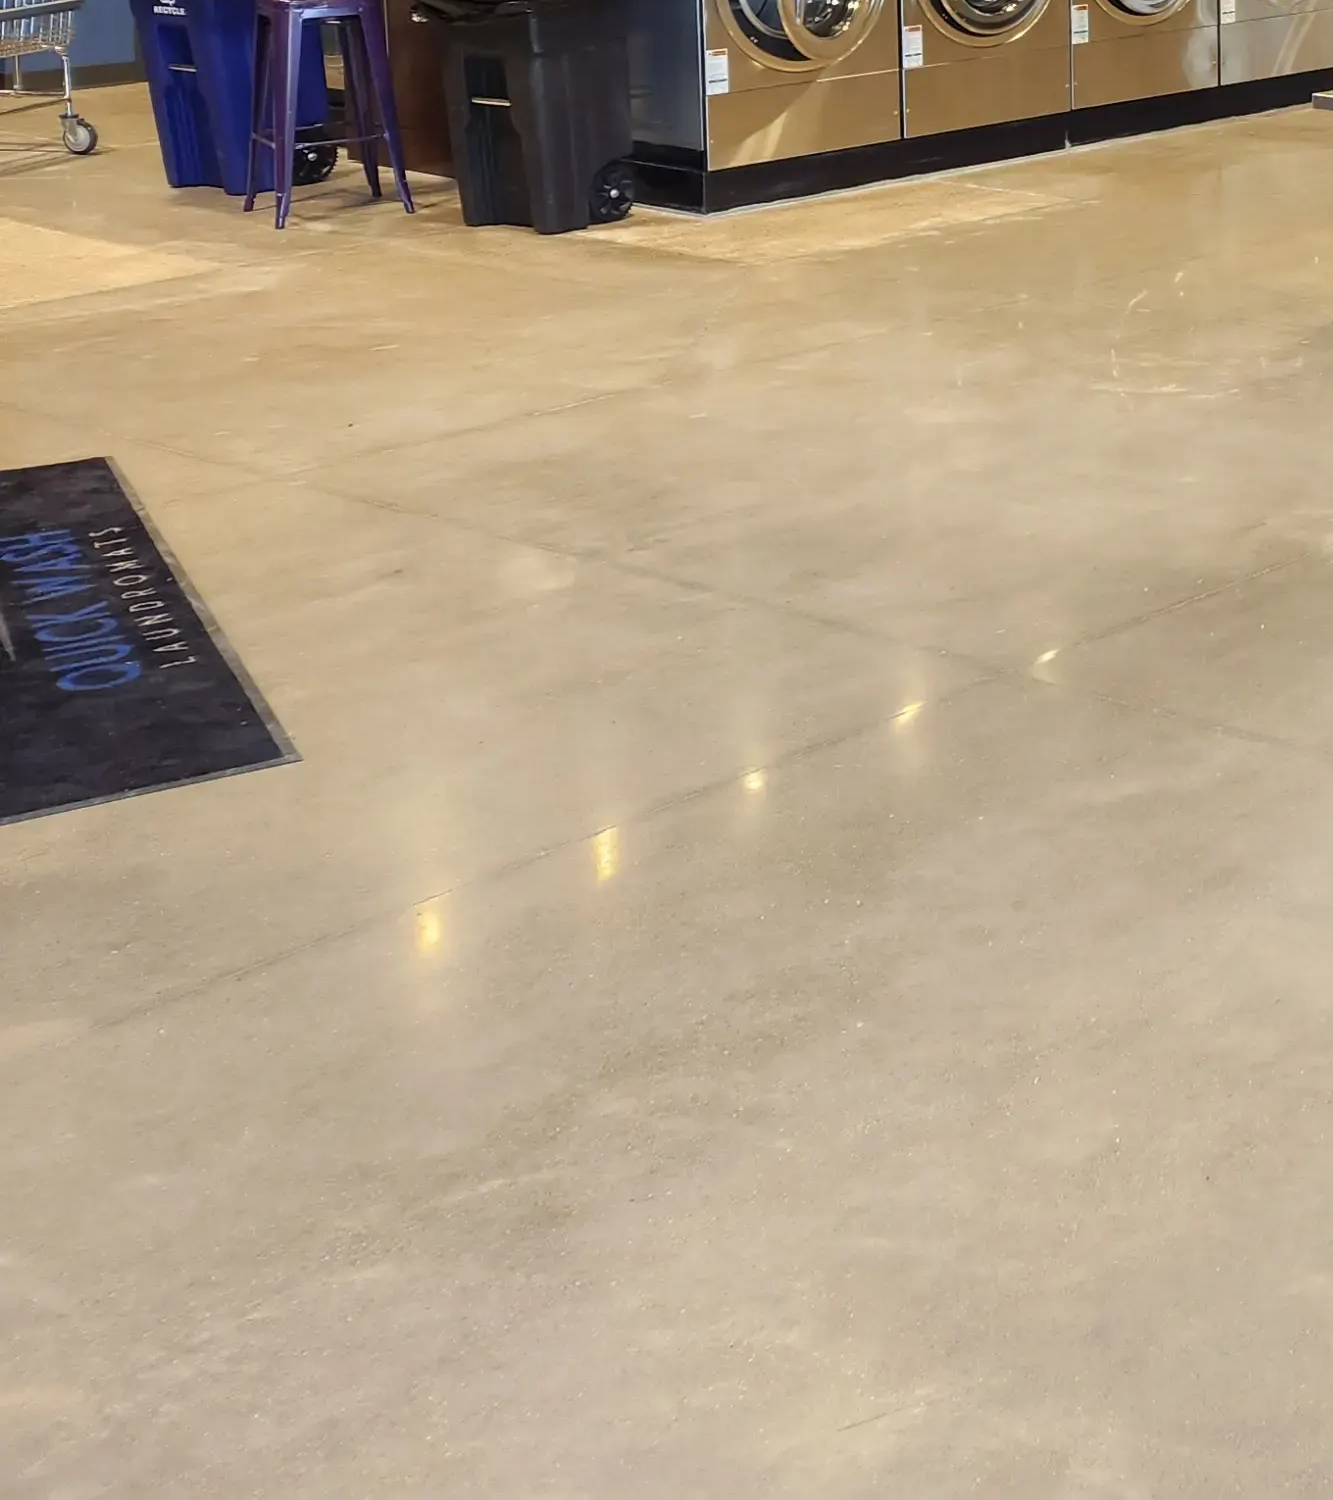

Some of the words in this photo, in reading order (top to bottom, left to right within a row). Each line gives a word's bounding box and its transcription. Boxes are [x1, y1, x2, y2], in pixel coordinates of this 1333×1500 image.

[153, 5, 187, 16] RECYCLE
[0, 529, 98, 605] WASH
[88, 527, 196, 669] LAUNDROMATS
[25, 601, 141, 691] QUICK
